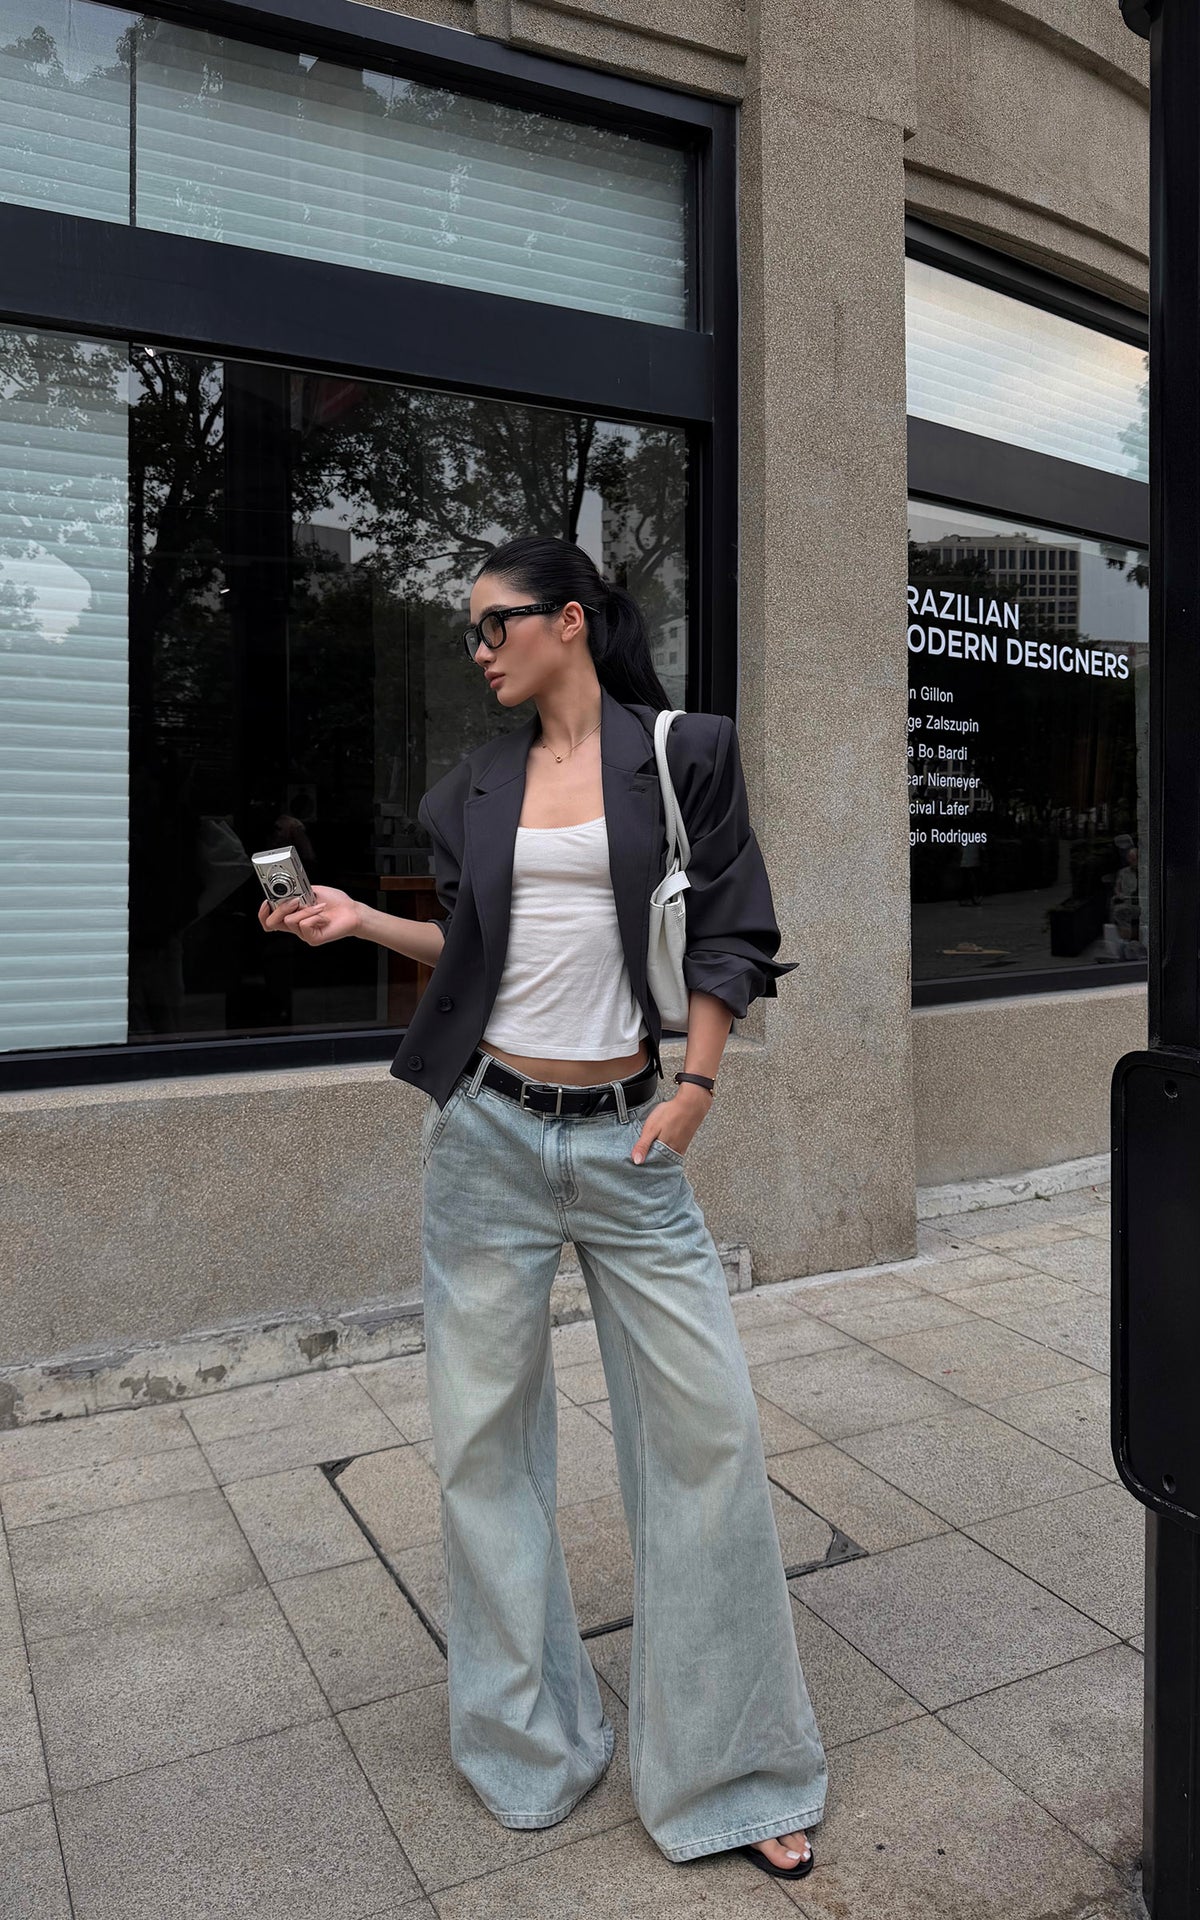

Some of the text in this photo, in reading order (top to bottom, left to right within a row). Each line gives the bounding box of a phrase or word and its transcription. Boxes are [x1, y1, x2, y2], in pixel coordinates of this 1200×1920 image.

[907, 585, 1019, 630] RAZILIAN
[907, 624, 1129, 680] ODERN DESIGNERS
[920, 686, 954, 703] Gillon
[926, 714, 979, 735] Zalszupin
[918, 743, 934, 758] Bo
[938, 744, 968, 760] Bardi
[907, 772, 980, 791] car Niemeyer
[908, 800, 969, 816] cival Lafer
[909, 828, 988, 847] gio Rodrigues
